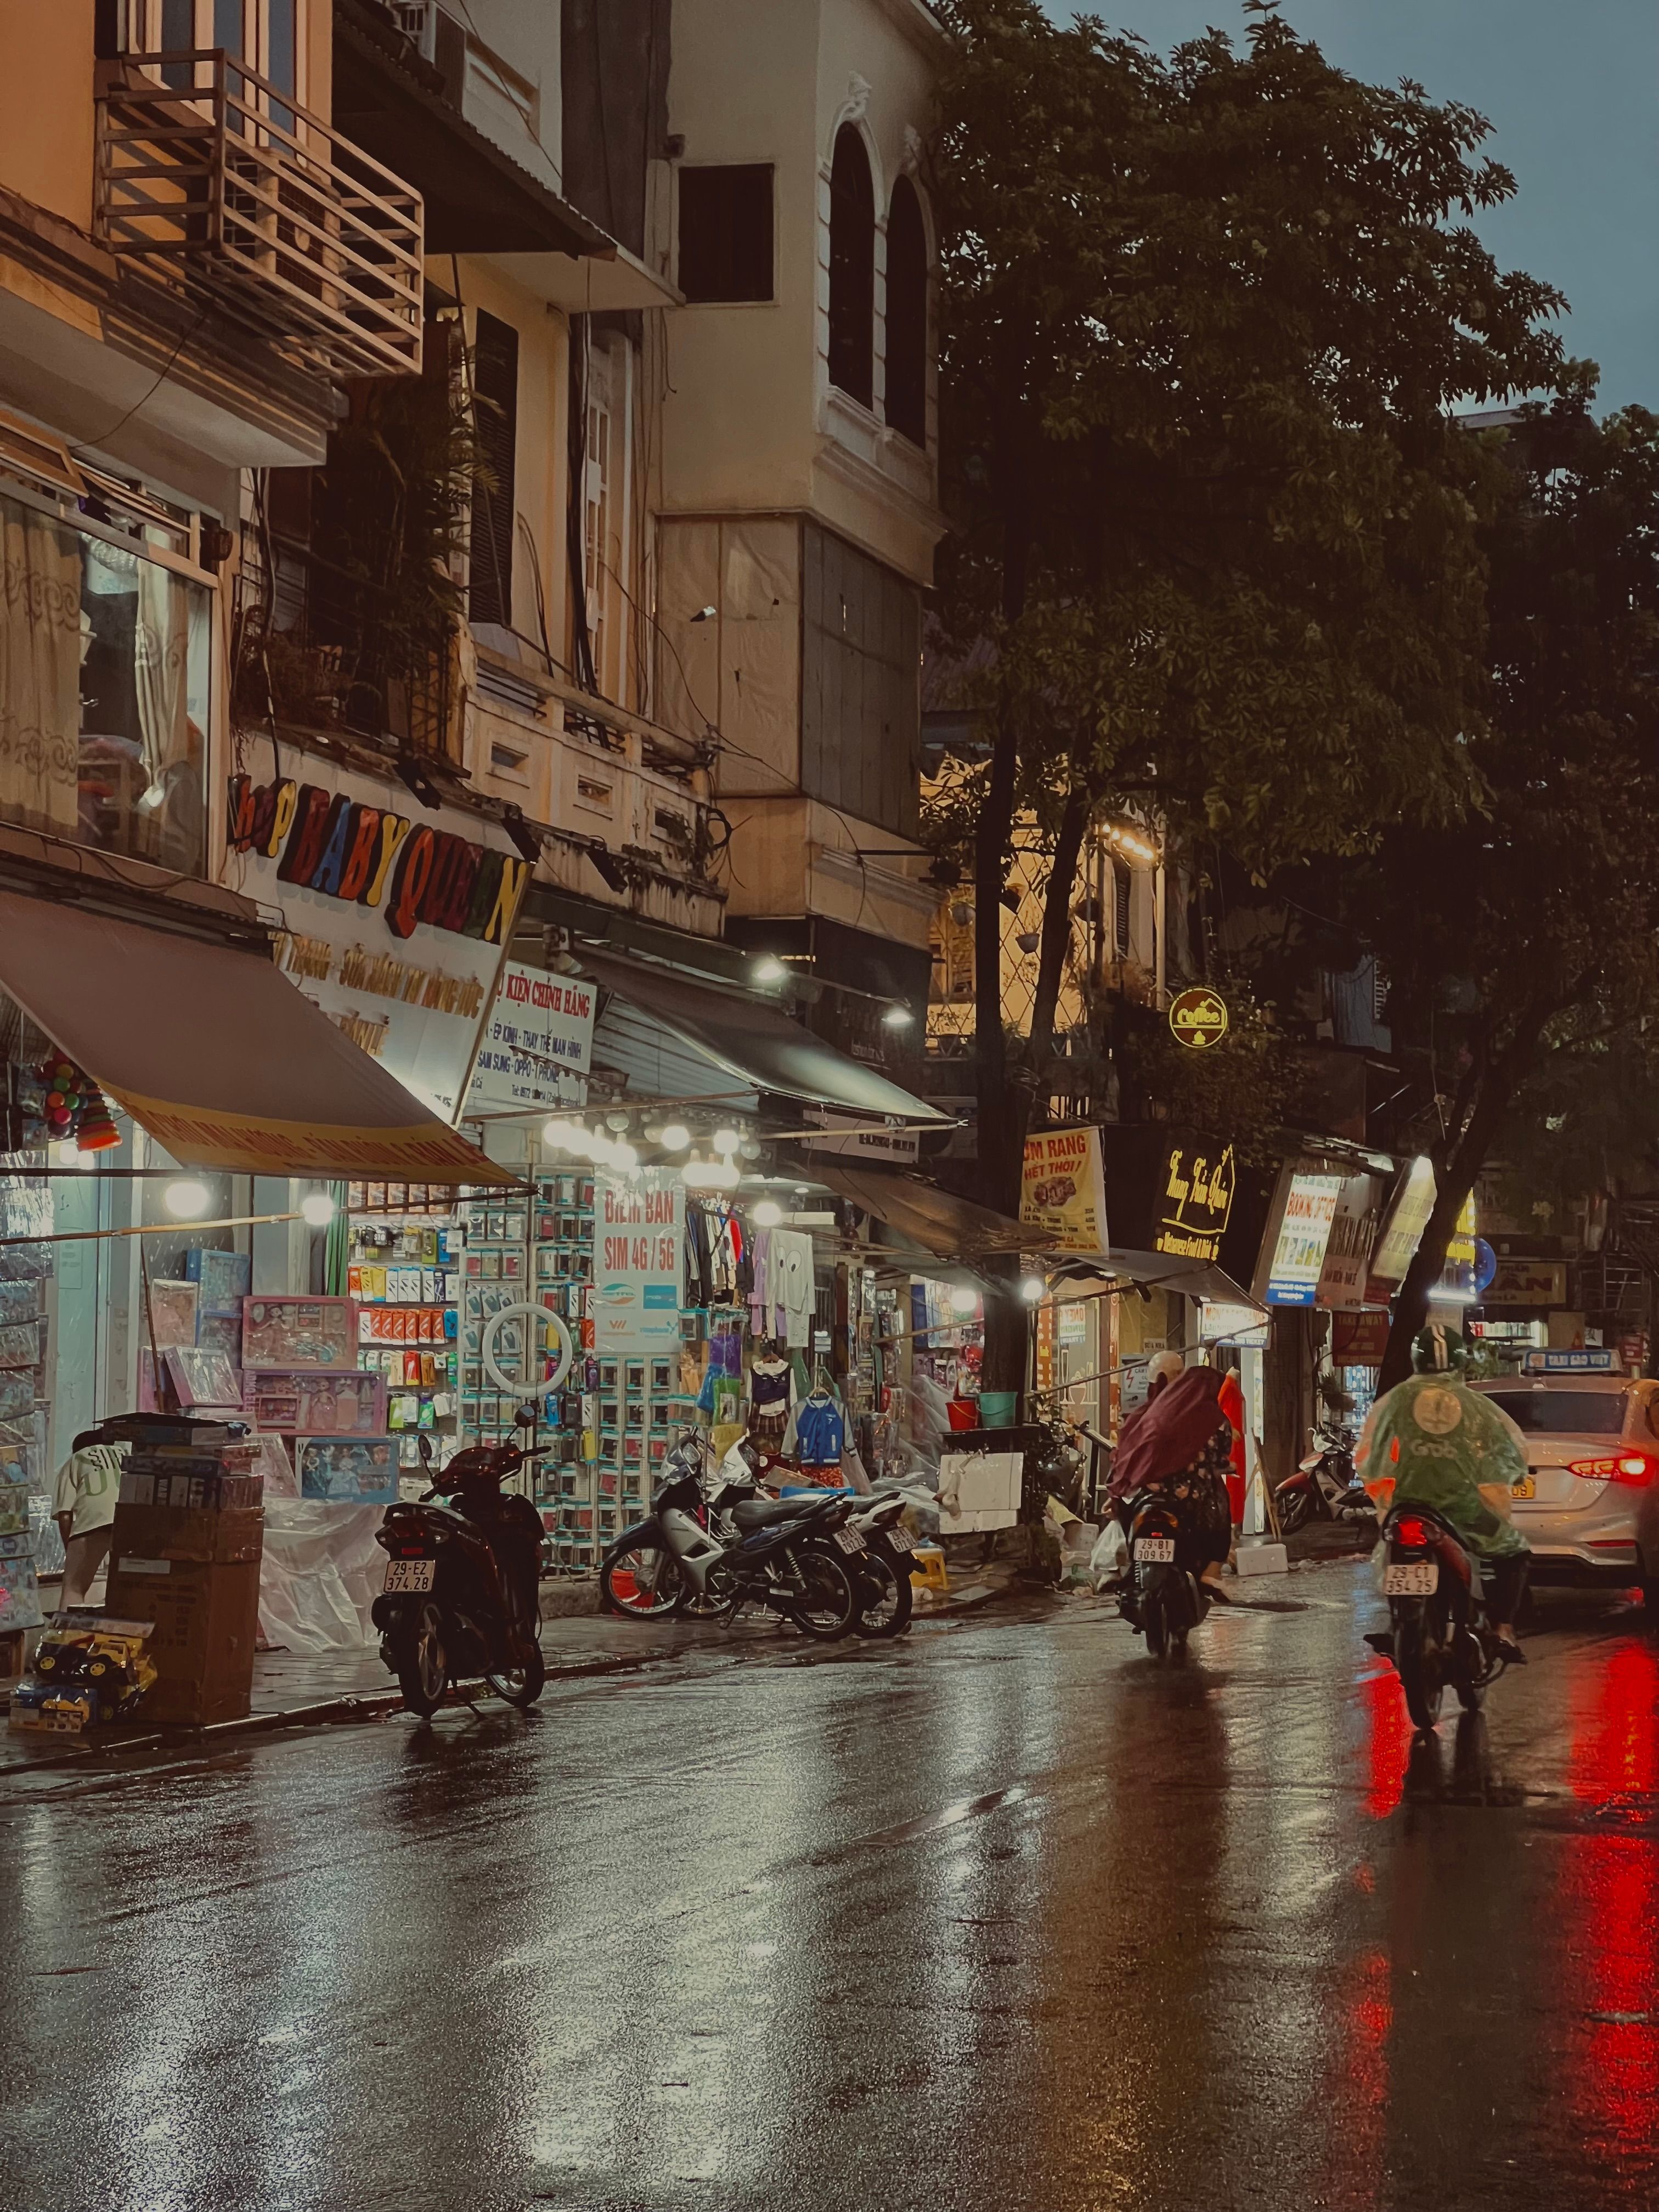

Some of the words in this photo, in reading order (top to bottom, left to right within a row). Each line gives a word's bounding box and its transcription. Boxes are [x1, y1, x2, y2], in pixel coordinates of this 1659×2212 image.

[277, 783, 410, 908] BABY
[385, 824, 528, 945] QUEEN
[506, 970, 531, 1007] KIỆN
[532, 977, 562, 1012] CHÍNH
[1024, 1141, 1045, 1161] ƠM
[1047, 1135, 1086, 1158] RANG
[605, 1237, 628, 1271] SIM
[632, 1237, 648, 1271] 4G
[659, 1237, 675, 1271] 5G
[1409, 1439, 1458, 1458] Grab
[1142, 1540, 1169, 1550] 29-B1
[393, 1562, 427, 1576] 29-E2
[387, 1577, 428, 1590] 374.28
